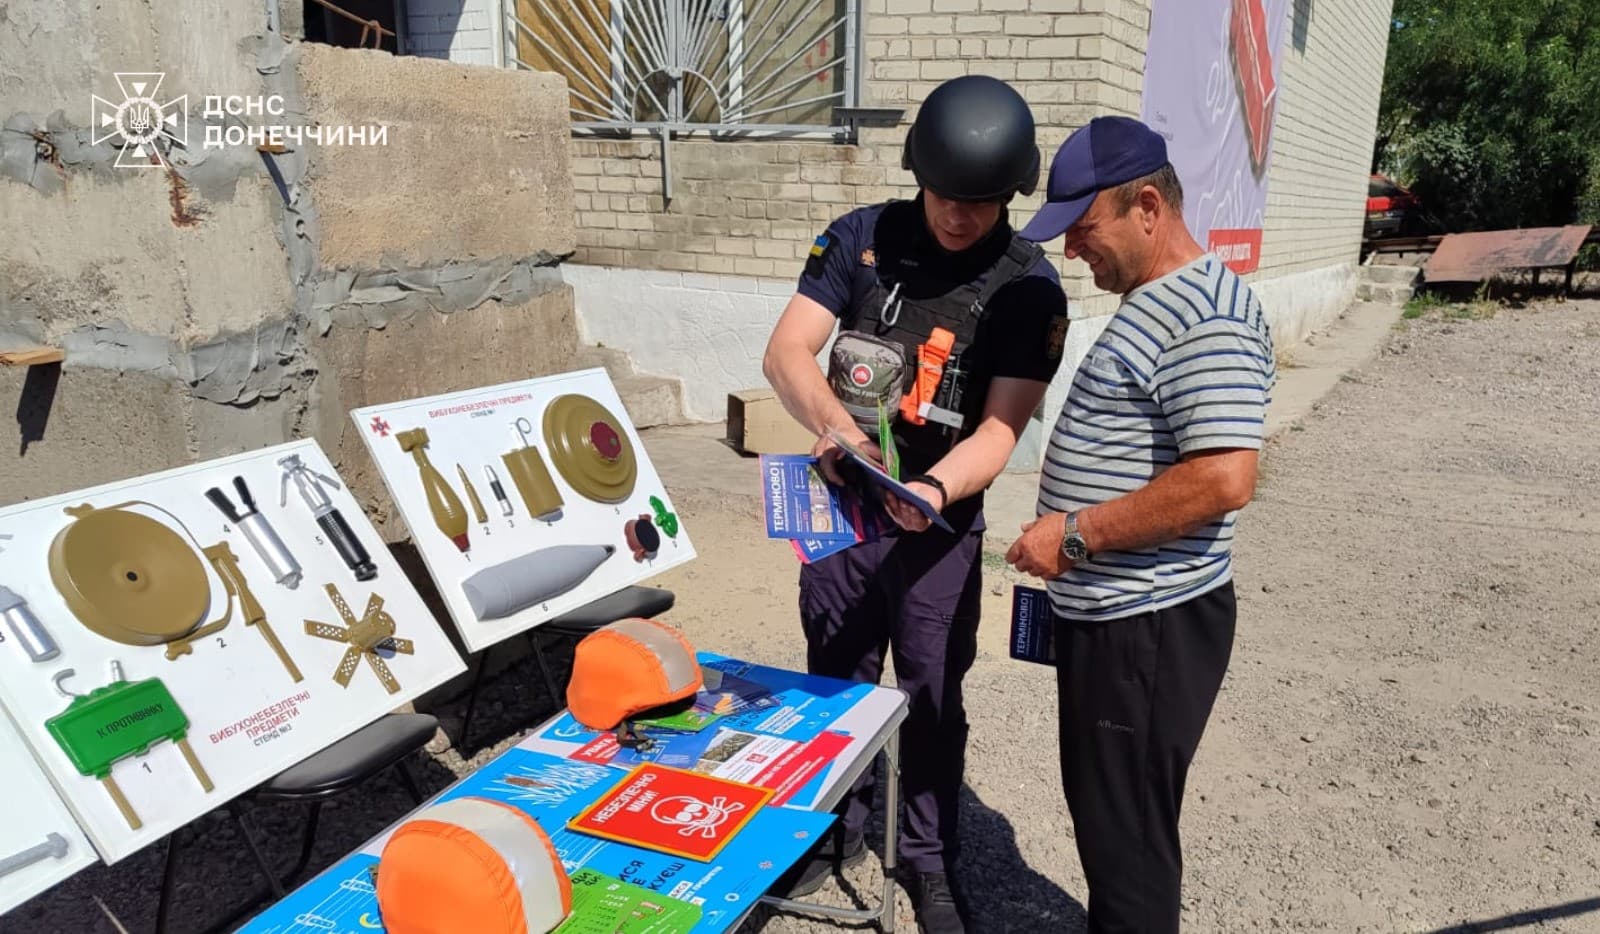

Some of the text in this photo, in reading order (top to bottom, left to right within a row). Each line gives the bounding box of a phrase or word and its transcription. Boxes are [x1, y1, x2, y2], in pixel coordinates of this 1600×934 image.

[216, 637, 227, 648] 2
[209, 690, 311, 744] ВИБУХОНЕБЕЗПЕЧНІ
[245, 707, 300, 739] ПРЕДМЕТИ
[253, 729, 281, 746] СТЕНД
[142, 761, 152, 773] 1
[591, 773, 657, 823] НЕБЕЗПЕЧНО
